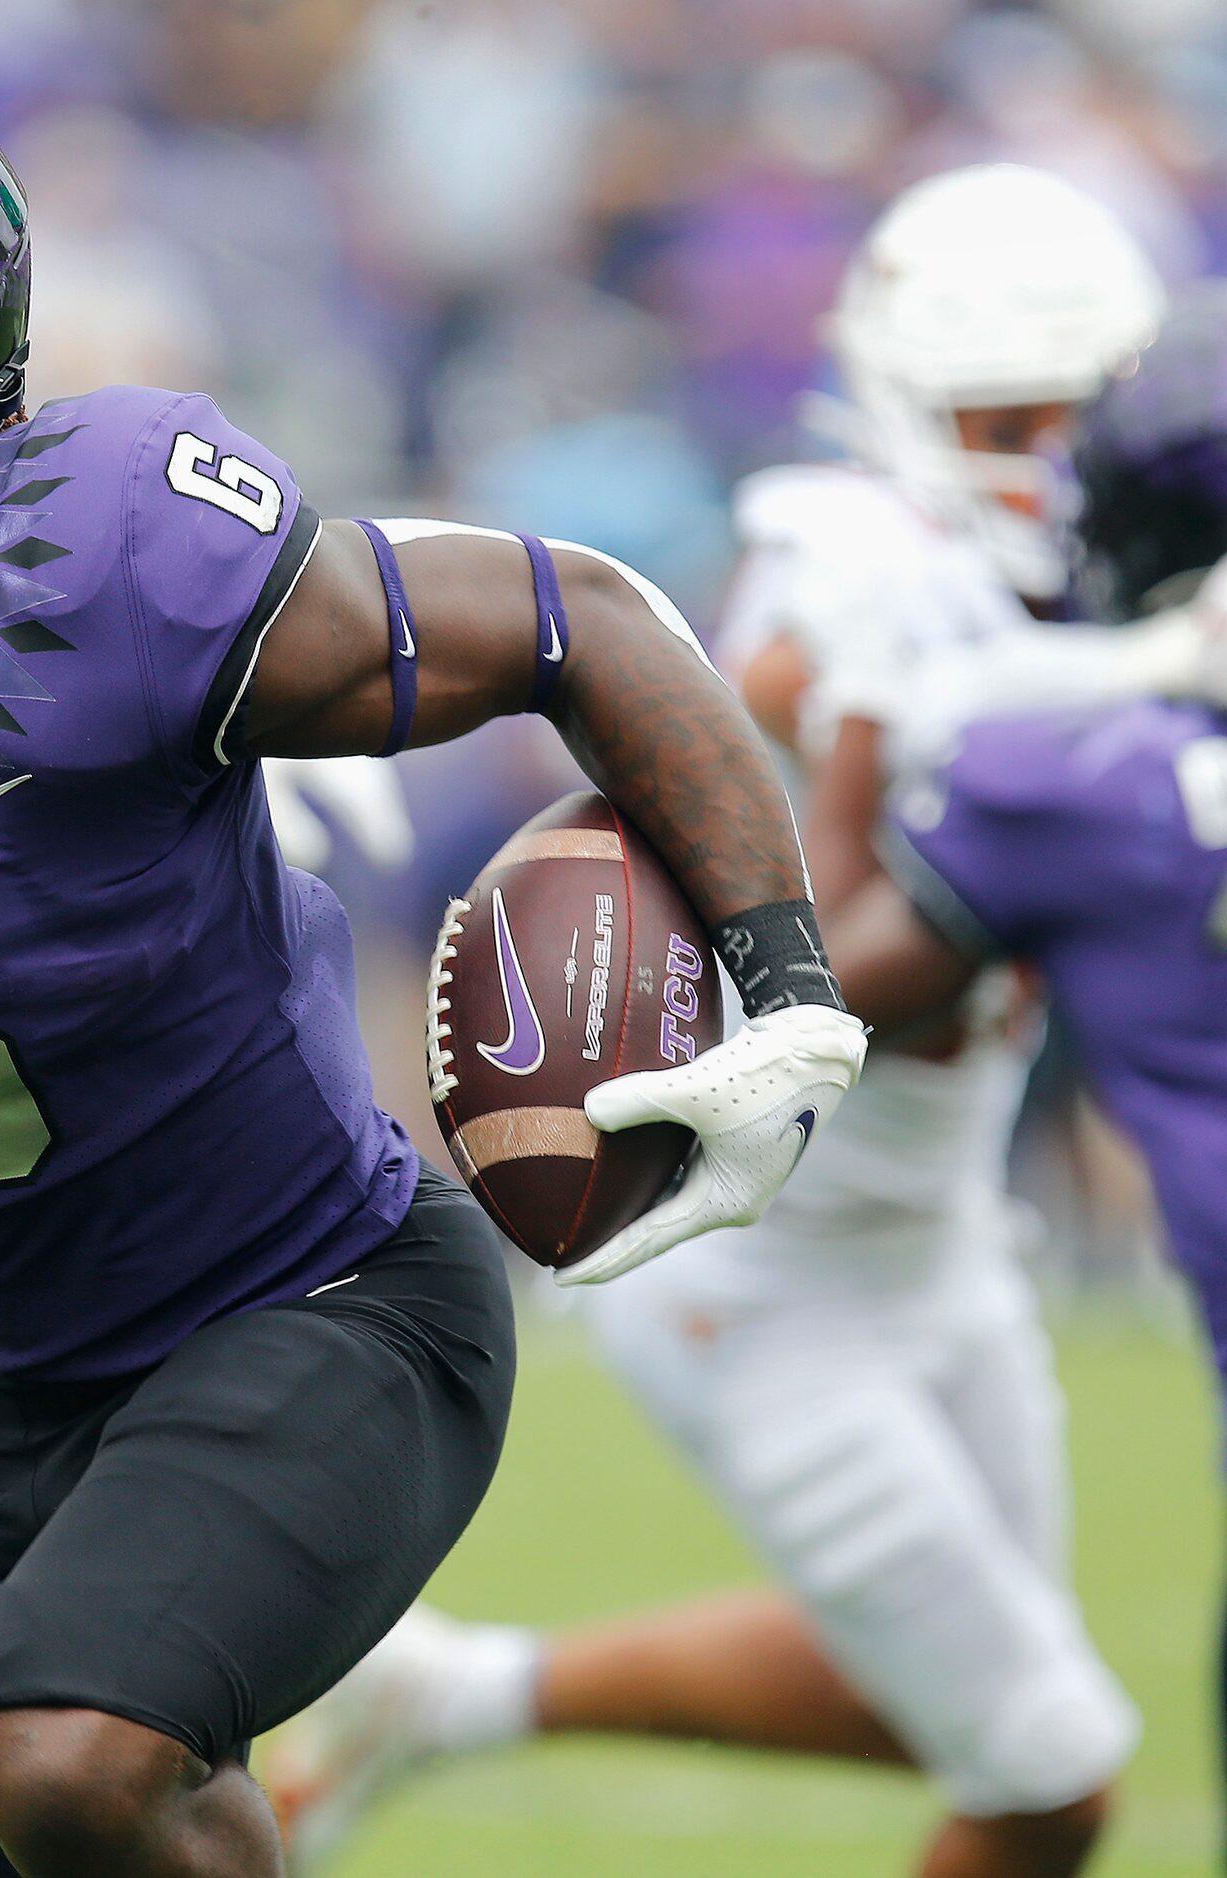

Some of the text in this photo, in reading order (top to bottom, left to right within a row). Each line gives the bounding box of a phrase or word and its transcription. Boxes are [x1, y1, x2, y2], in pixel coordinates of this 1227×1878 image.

[164, 431, 284, 536] 6
[637, 965, 655, 996] 25
[659, 931, 704, 1064] TCU
